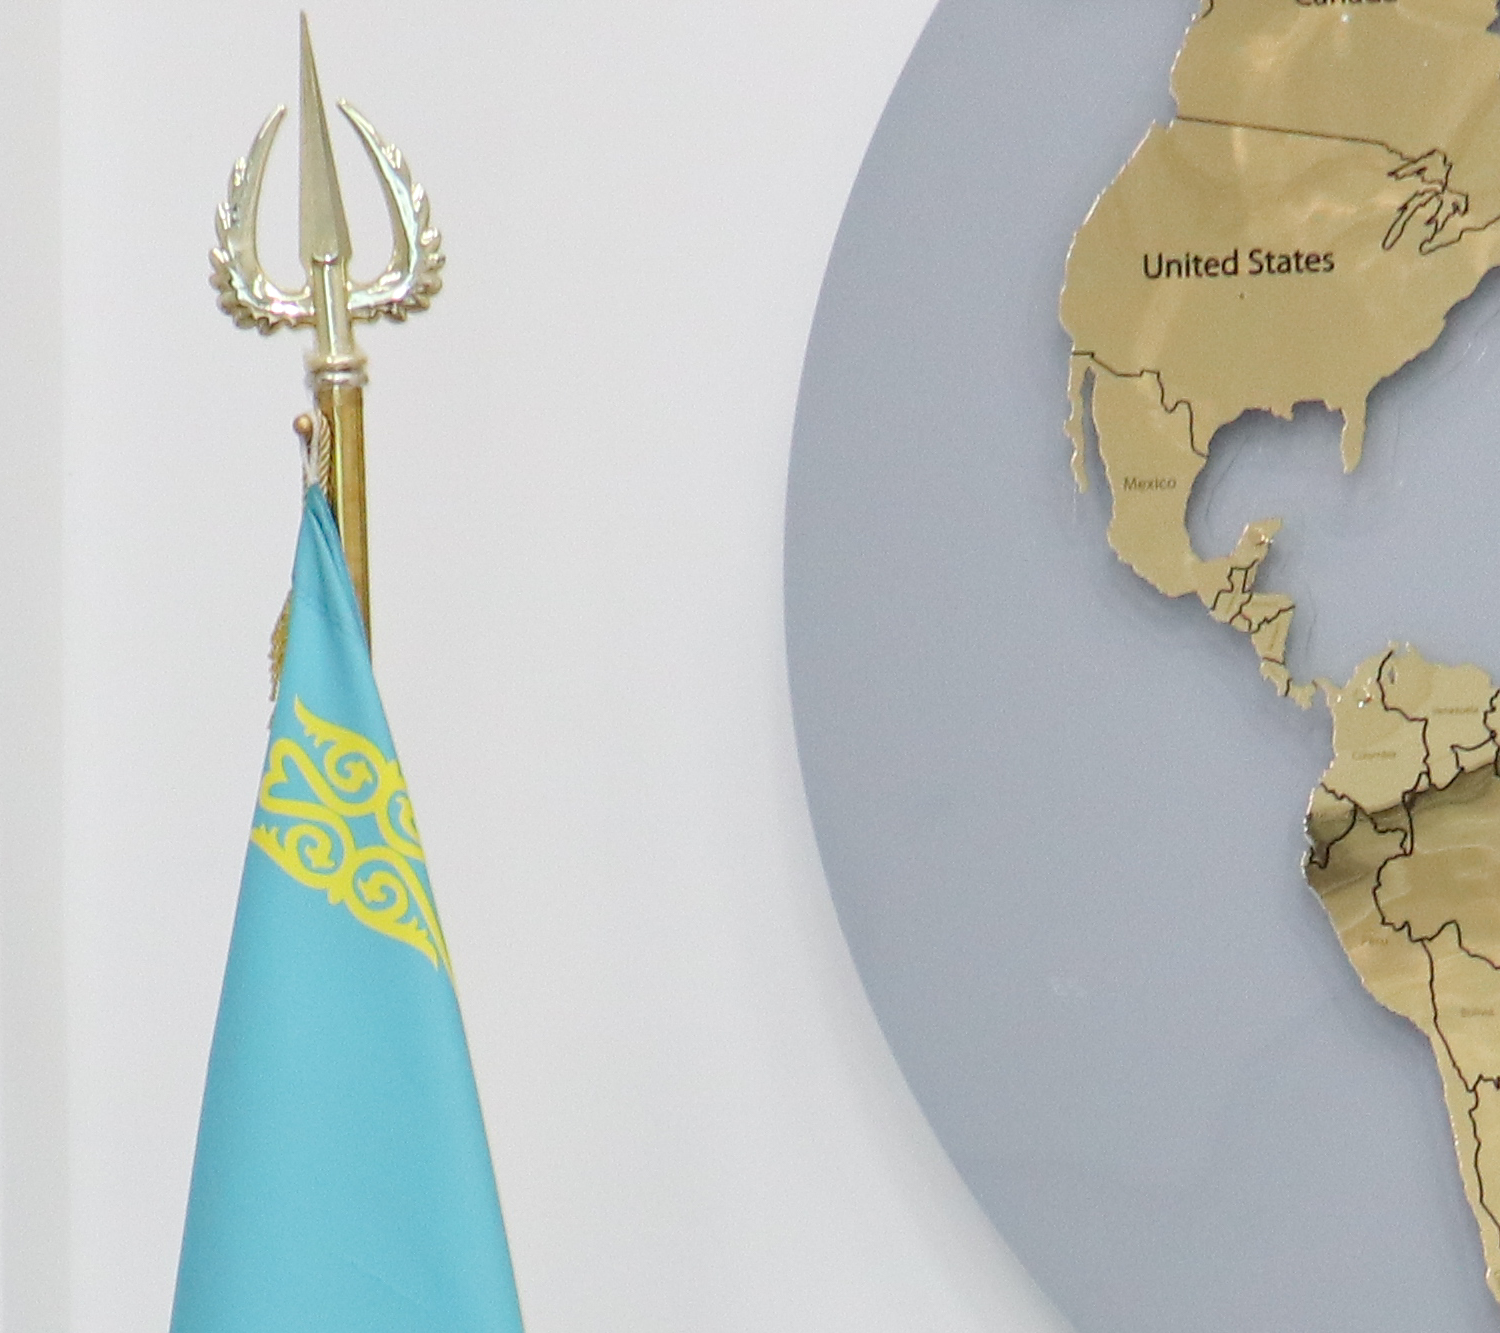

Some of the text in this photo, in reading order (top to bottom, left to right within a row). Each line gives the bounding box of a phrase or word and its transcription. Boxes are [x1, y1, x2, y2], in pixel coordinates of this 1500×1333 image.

[1143, 249, 1335, 279] United States
[1123, 476, 1176, 492] Mexico
